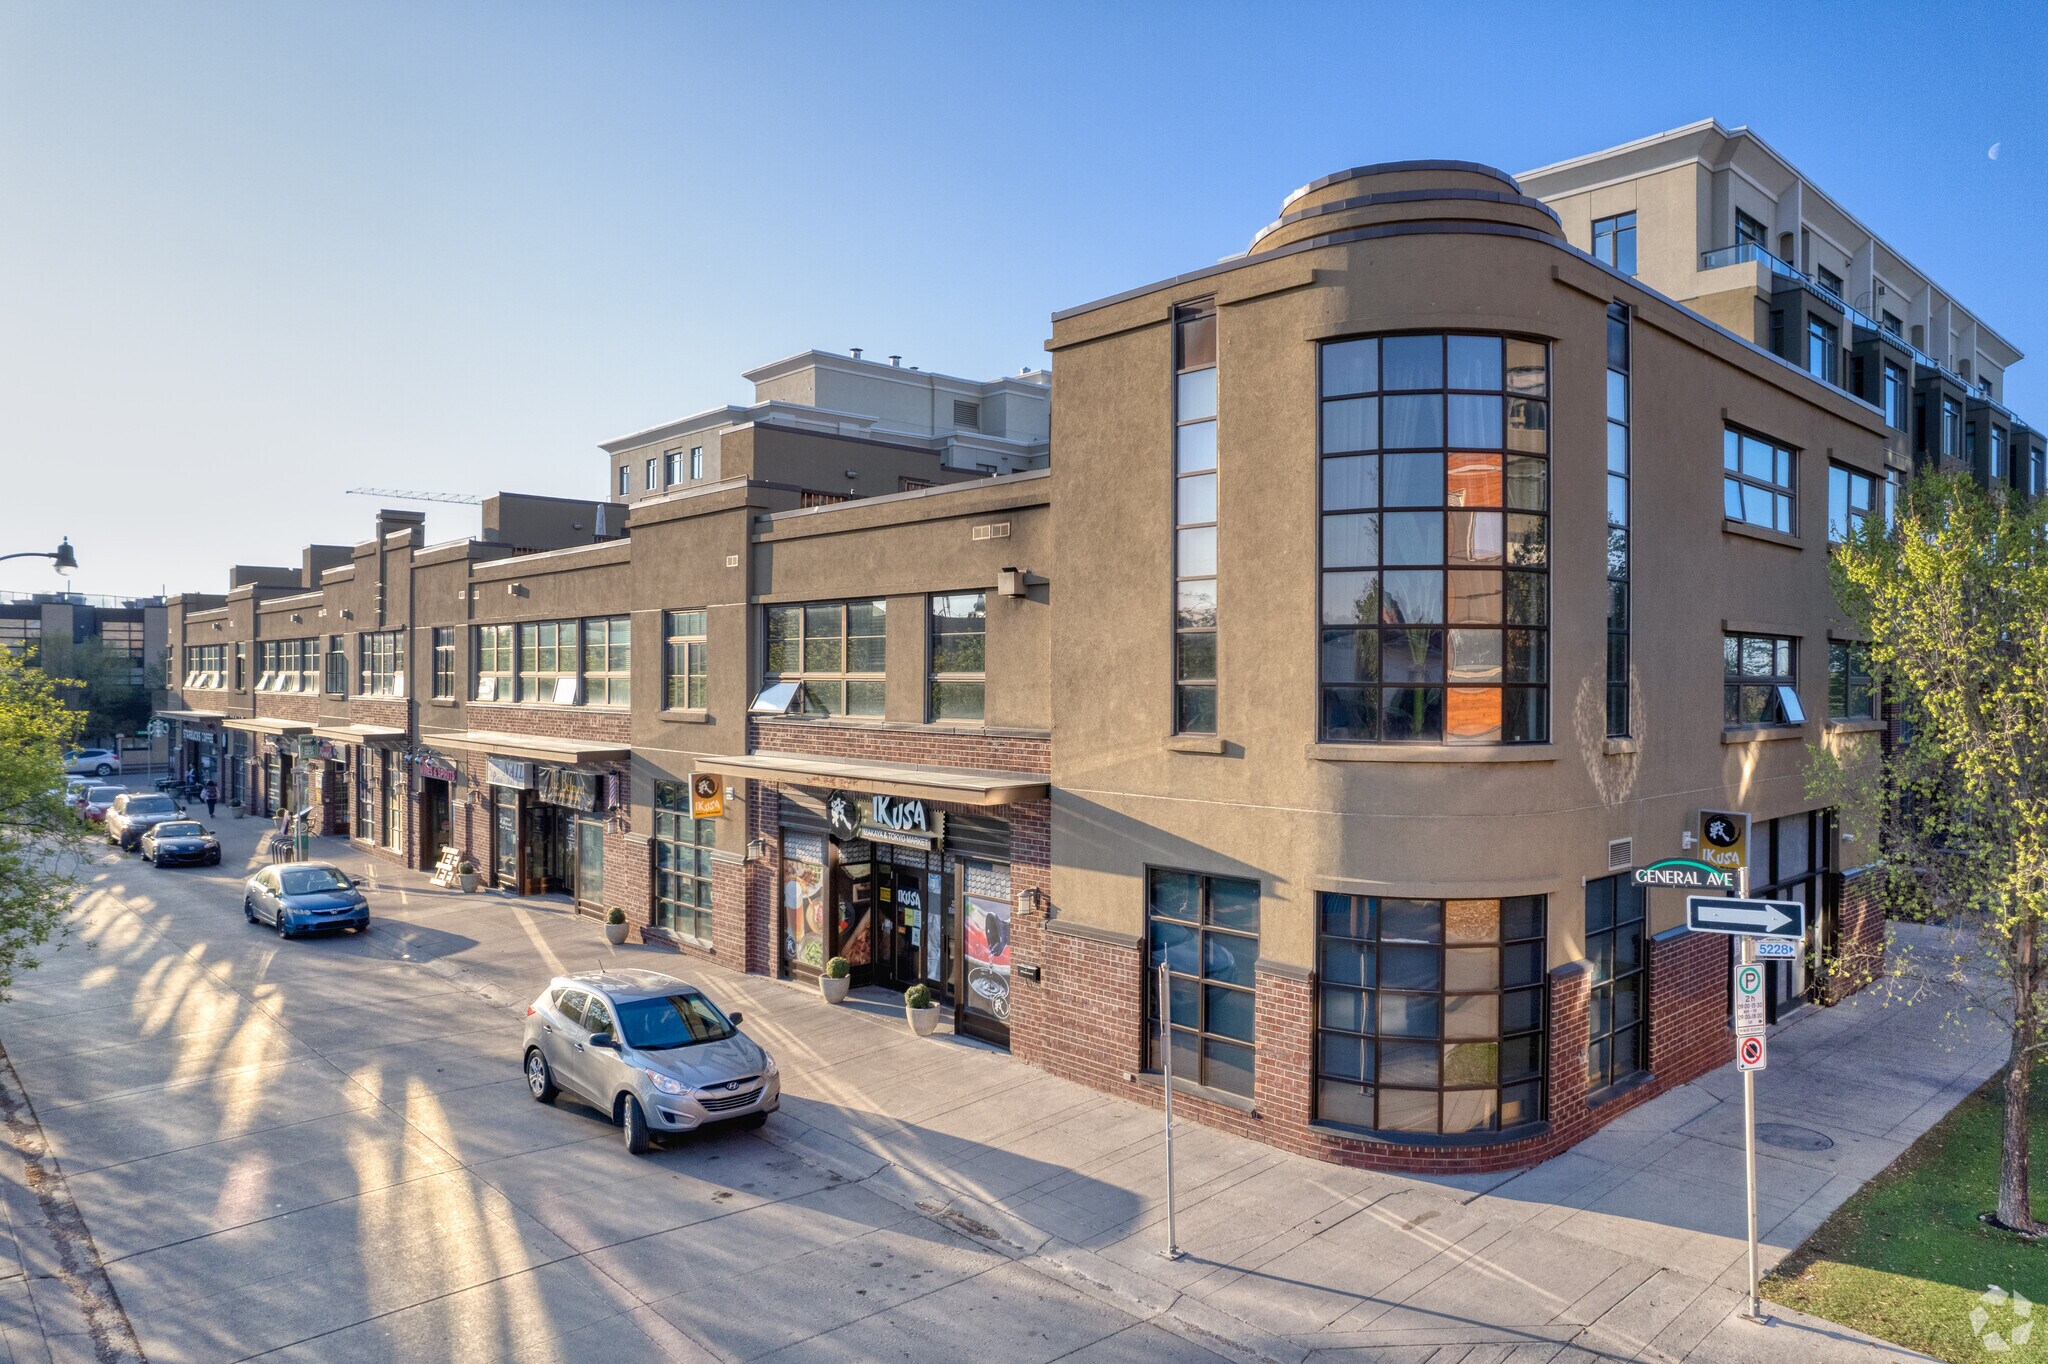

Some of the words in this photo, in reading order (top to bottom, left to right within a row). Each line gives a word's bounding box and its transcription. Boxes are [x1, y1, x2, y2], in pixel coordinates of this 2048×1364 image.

[695, 800, 720, 812] IKUSA
[873, 795, 926, 831] IKUSA
[883, 831, 888, 839] &
[888, 833, 905, 843] TOKYO
[906, 836, 928, 847] MARKET
[1702, 848, 1740, 865] IKUSA
[1635, 869, 1702, 885] GENERAL
[1706, 872, 1734, 887] AVE
[897, 889, 921, 910] IKUSA
[1759, 944, 1789, 955] 5228
[1745, 973, 1756, 989] P
